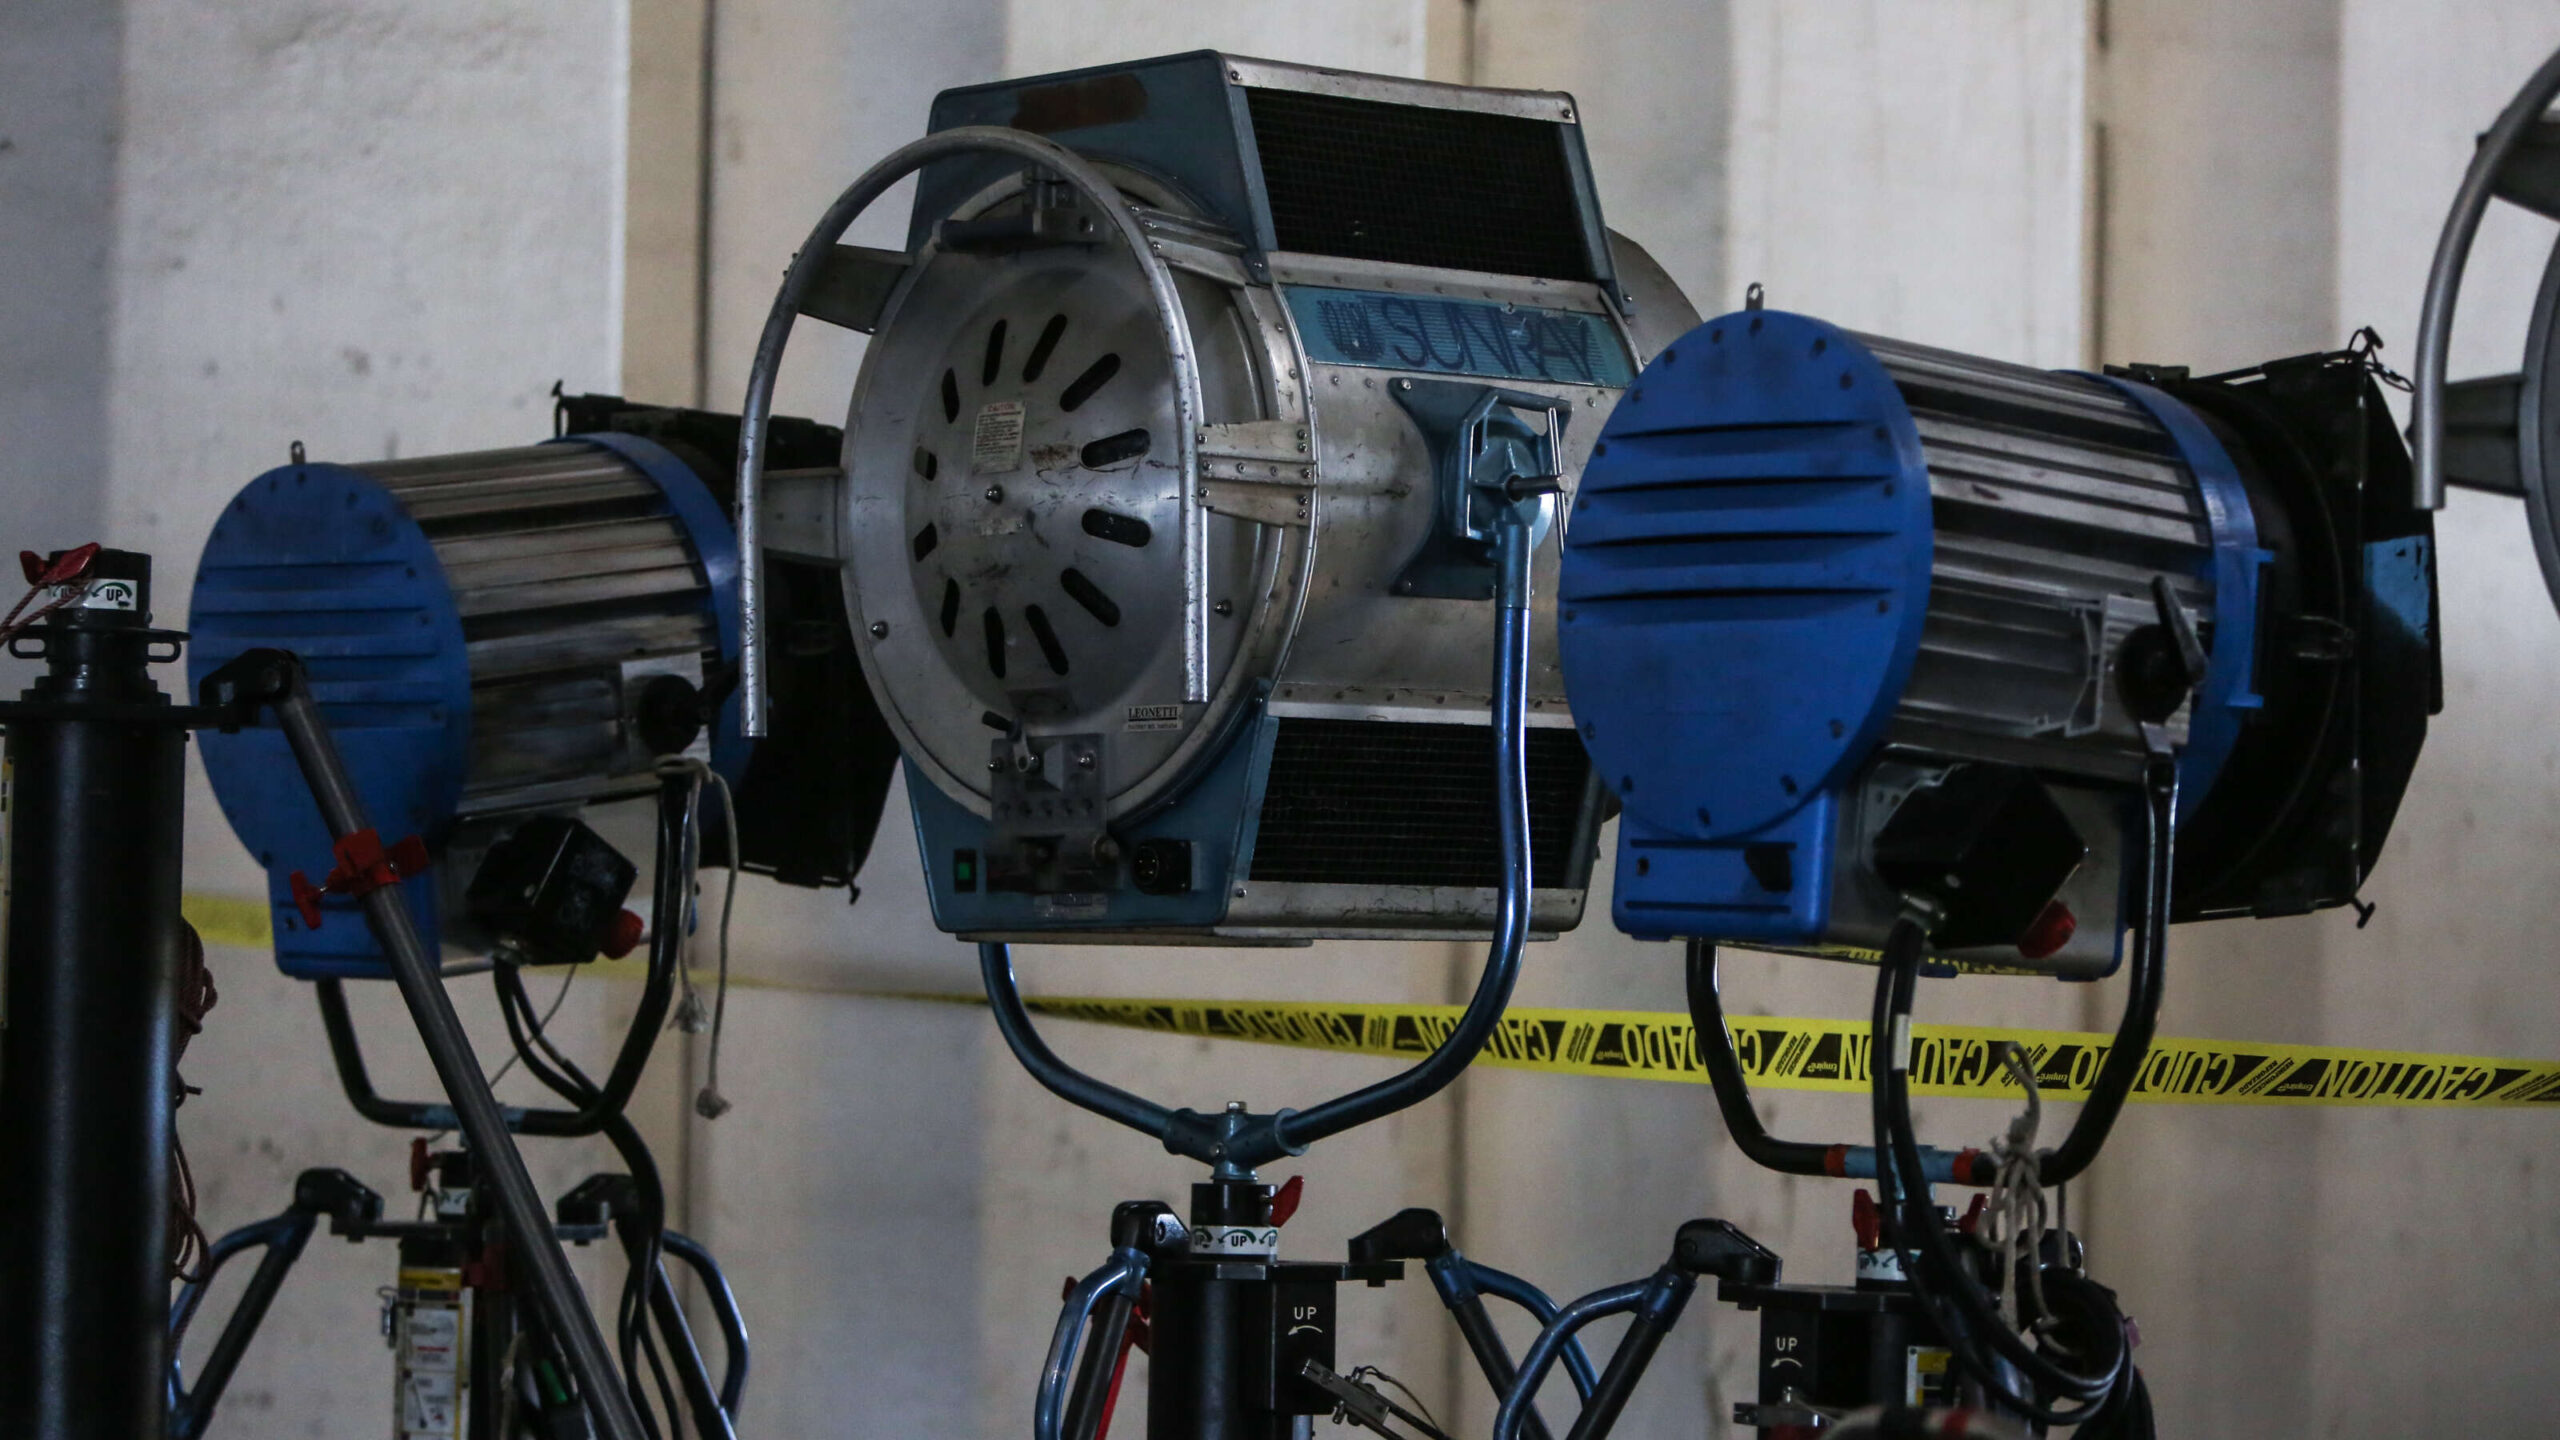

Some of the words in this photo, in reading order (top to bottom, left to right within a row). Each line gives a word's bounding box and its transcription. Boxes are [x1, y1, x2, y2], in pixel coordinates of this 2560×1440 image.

[1381, 298, 1595, 381] SUNRAY
[106, 589, 123, 601] UP
[1413, 1016, 1551, 1062] CAUON
[2316, 1060, 2497, 1101] CAUTION
[1231, 1235, 1247, 1247] UP
[1293, 1306, 1317, 1320] UP
[1776, 1337, 1798, 1351] UP
